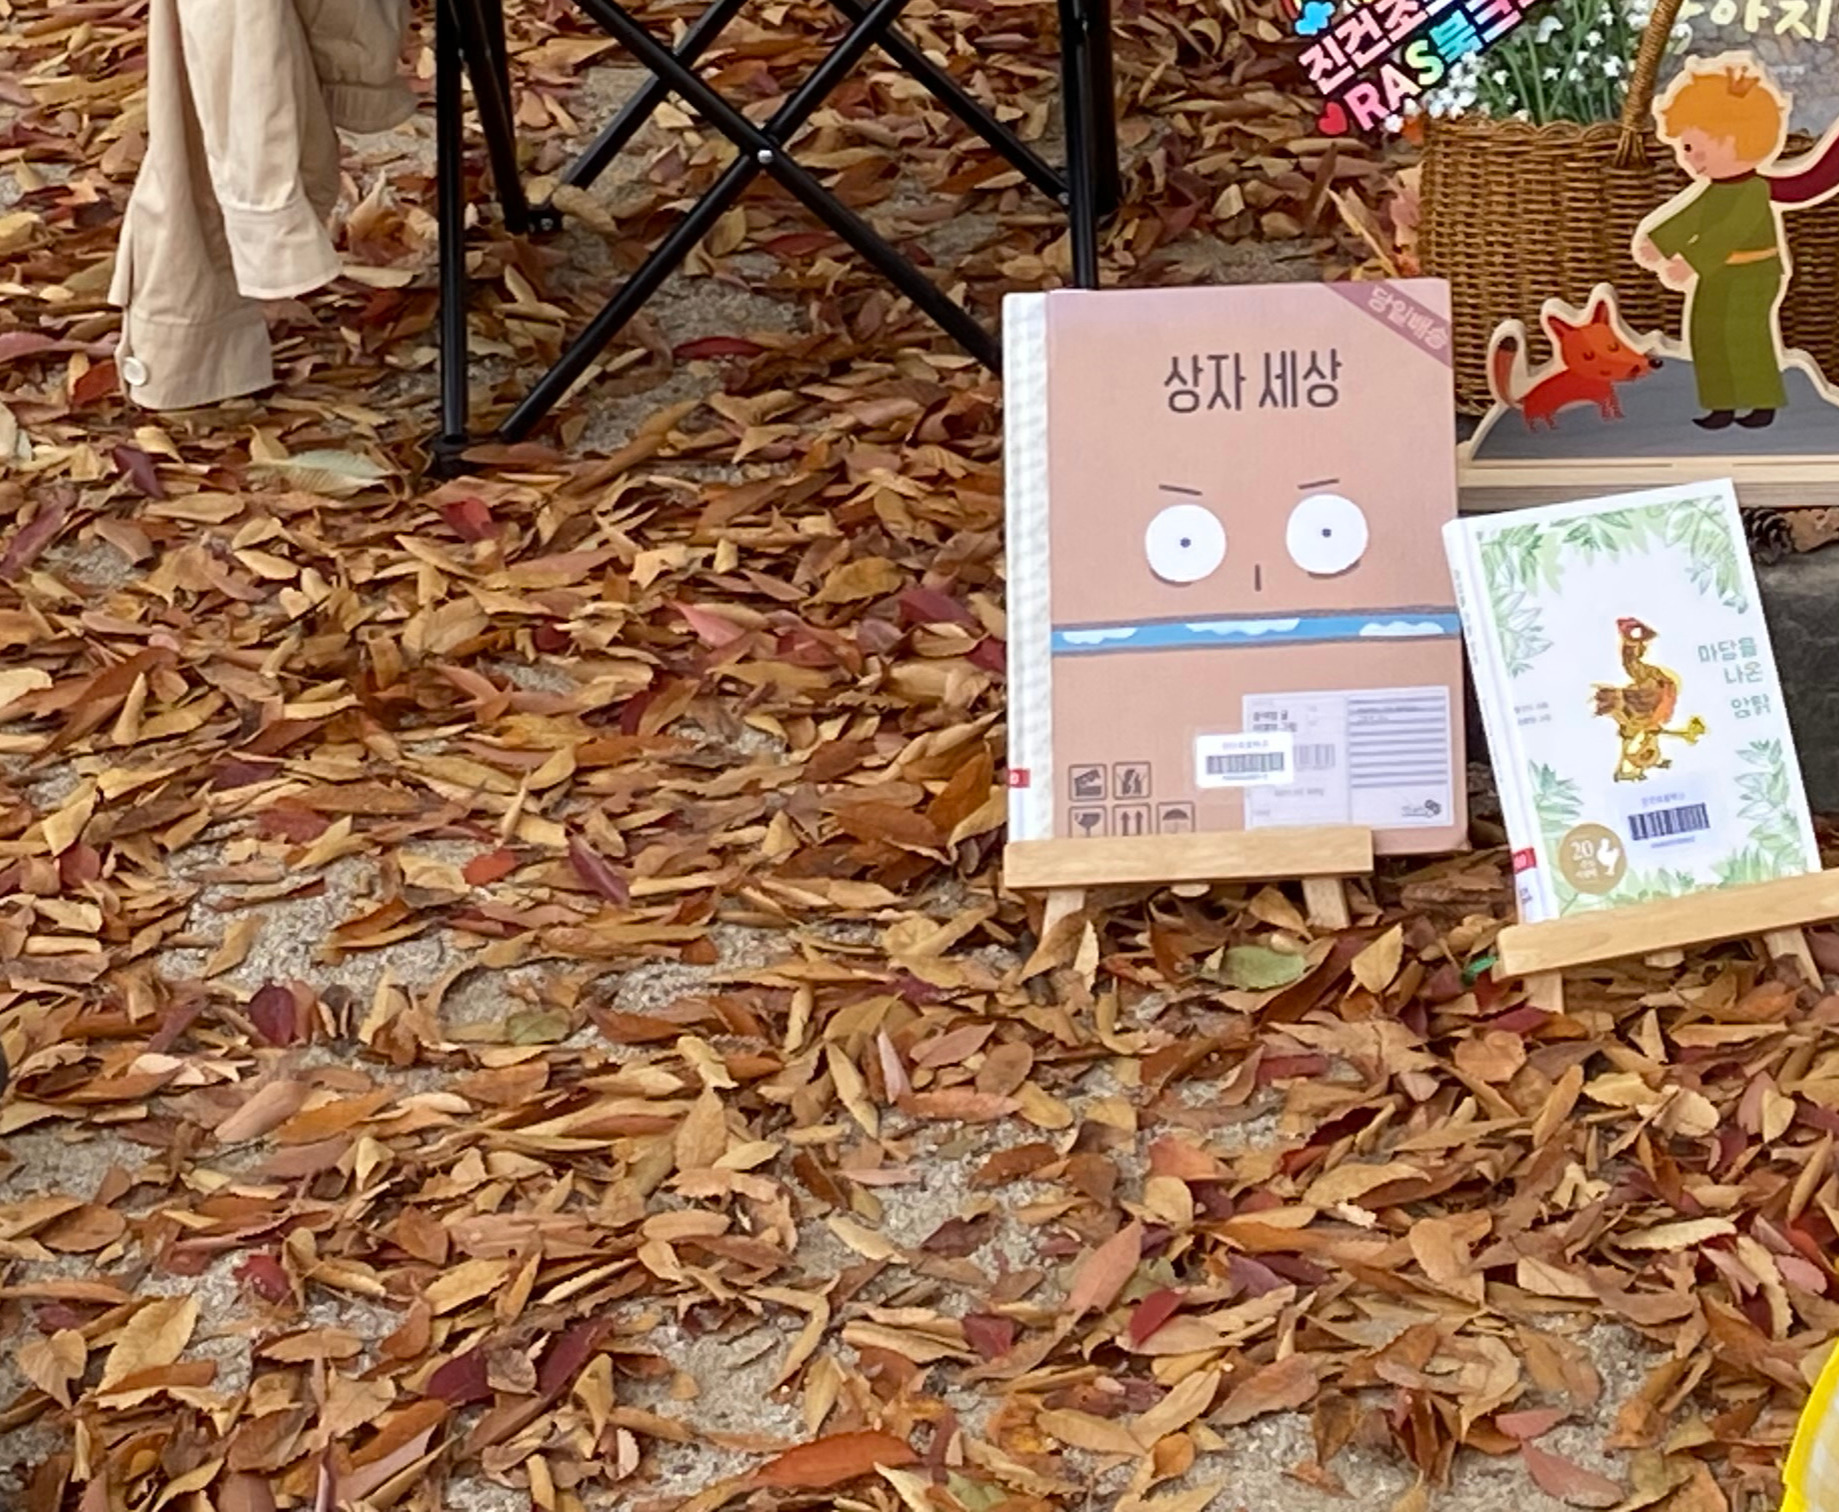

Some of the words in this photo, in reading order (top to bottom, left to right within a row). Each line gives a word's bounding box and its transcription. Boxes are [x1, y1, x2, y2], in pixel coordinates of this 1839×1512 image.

[1367, 284, 1449, 350] 당일배송
[1164, 352, 1247, 414] 상자
[1258, 348, 1343, 408] 세상
[1723, 661, 1763, 684] 나온
[1569, 839, 1595, 861] 20
